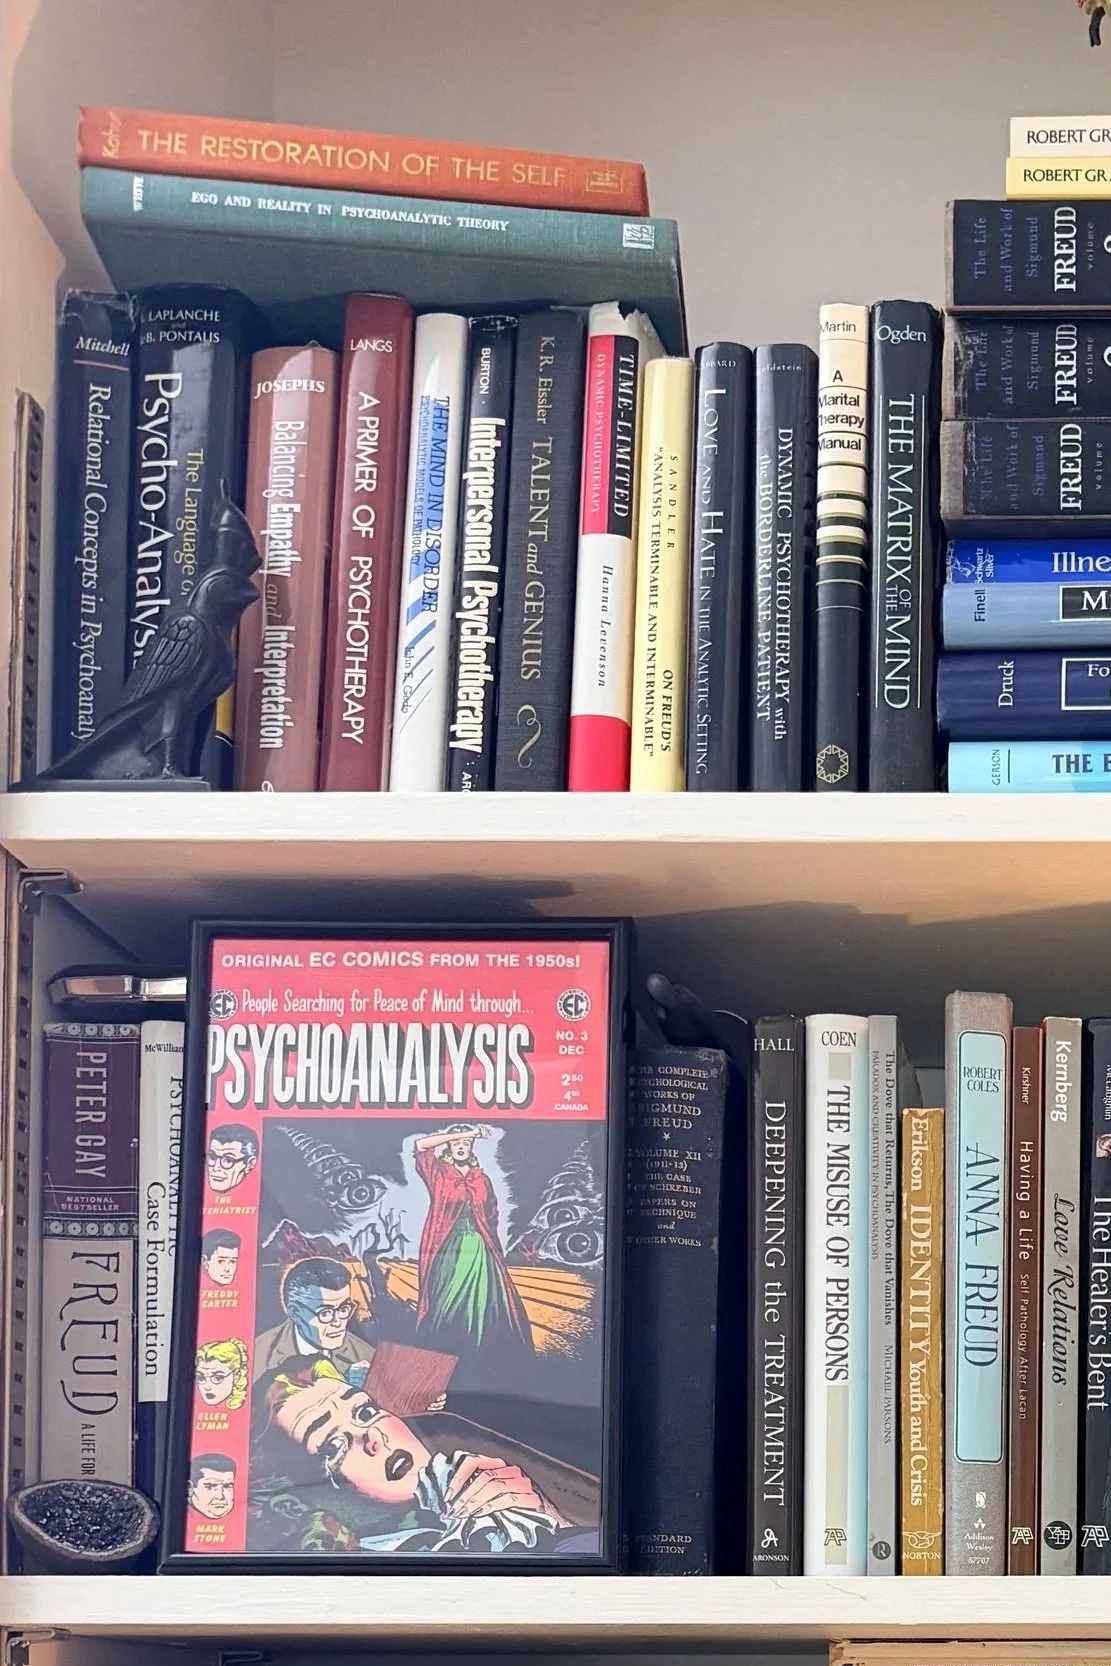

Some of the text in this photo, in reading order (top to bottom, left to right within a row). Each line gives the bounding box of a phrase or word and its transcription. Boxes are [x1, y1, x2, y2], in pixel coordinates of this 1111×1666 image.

[138, 128, 566, 187] THE RESTORATION OF THE SELF
[191, 191, 510, 232] EGO AND REALITY IN PSYCHOANALYTIC THEORY
[1054, 206, 1078, 292] FREUD
[349, 338, 393, 354] LANGS
[876, 324, 927, 345] Ogden
[1060, 423, 1084, 510] FREUD
[448, 416, 506, 757] Interpersonal Psychotherapy
[221, 952, 581, 968] ORIGINAL EC COMICS FROM THE 1950s!
[242, 991, 279, 1015] People
[283, 990, 344, 1017] Searching
[350, 989, 367, 1012] for
[373, 989, 408, 1013] Peace
[411, 988, 428, 1012] of
[431, 988, 464, 1013] Mind
[555, 1031, 588, 1041] NO. 3
[558, 1045, 584, 1055] DEC
[207, 1023, 535, 1110] PSYCHOANALYSIS
[963, 1066, 1002, 1081] ROBERT
[967, 1080, 999, 1093] COLES
[1051, 1040, 1072, 1123] Kernberg
[74, 1051, 107, 1178] PETER GAY
[964, 1144, 1000, 1368] ANNA FREUD
